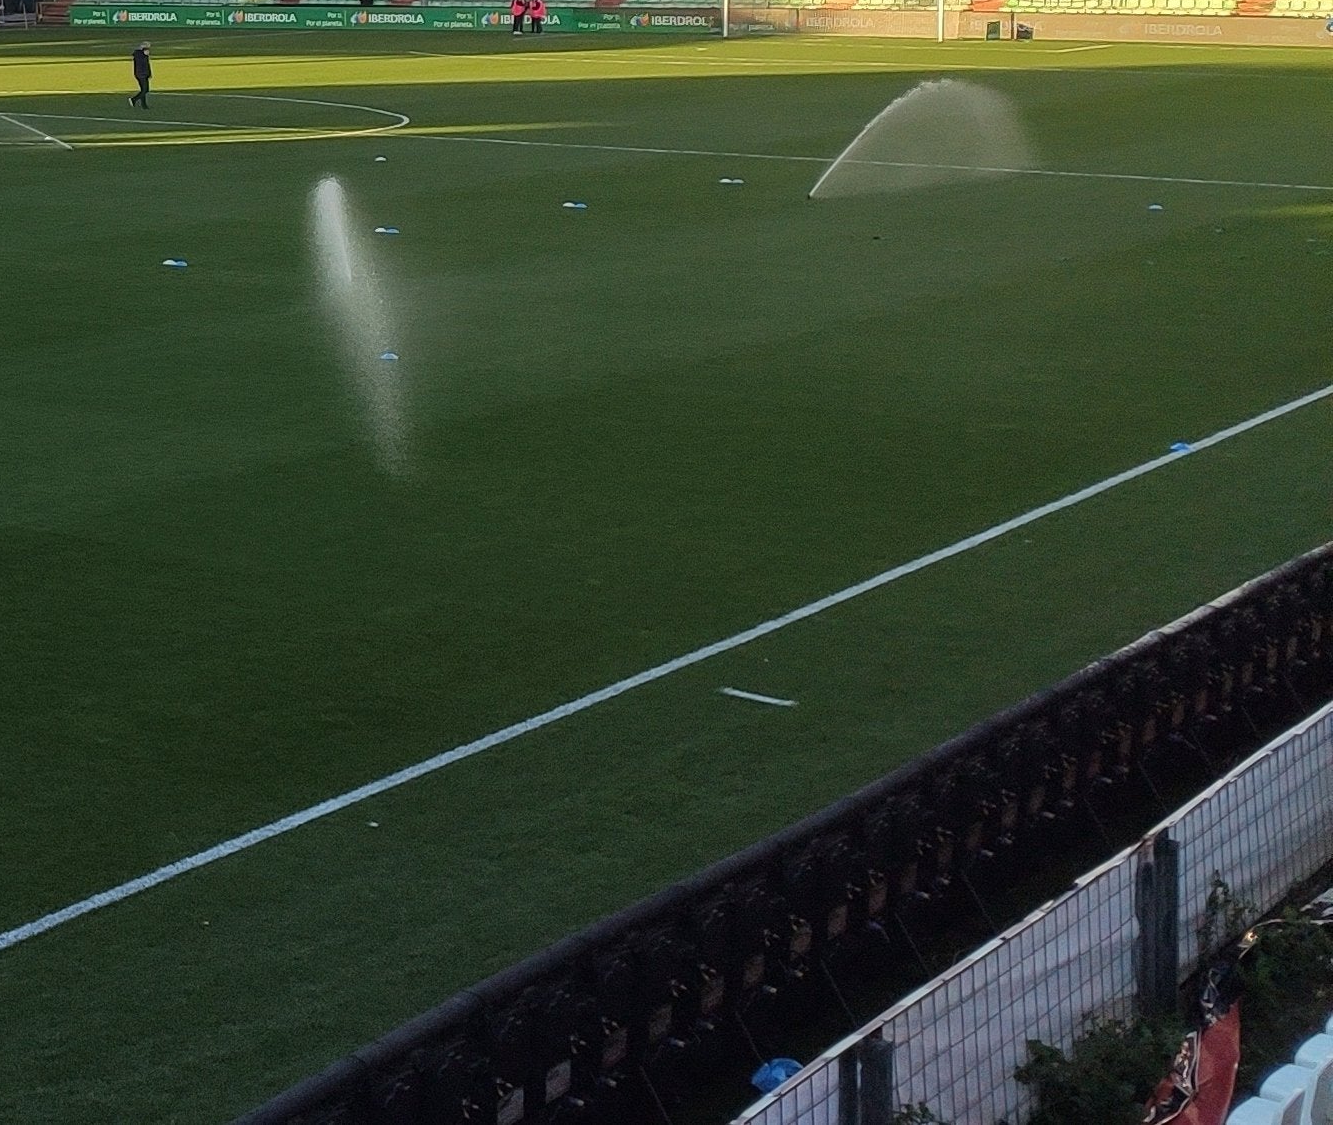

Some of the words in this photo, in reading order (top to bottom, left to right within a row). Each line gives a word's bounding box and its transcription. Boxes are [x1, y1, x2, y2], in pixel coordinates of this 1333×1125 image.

[128, 12, 178, 22] IBERDROLA
[244, 12, 297, 23] IBERDROLA
[368, 13, 425, 24] IBERDROLA
[1144, 23, 1222, 35] IBERDROLA
